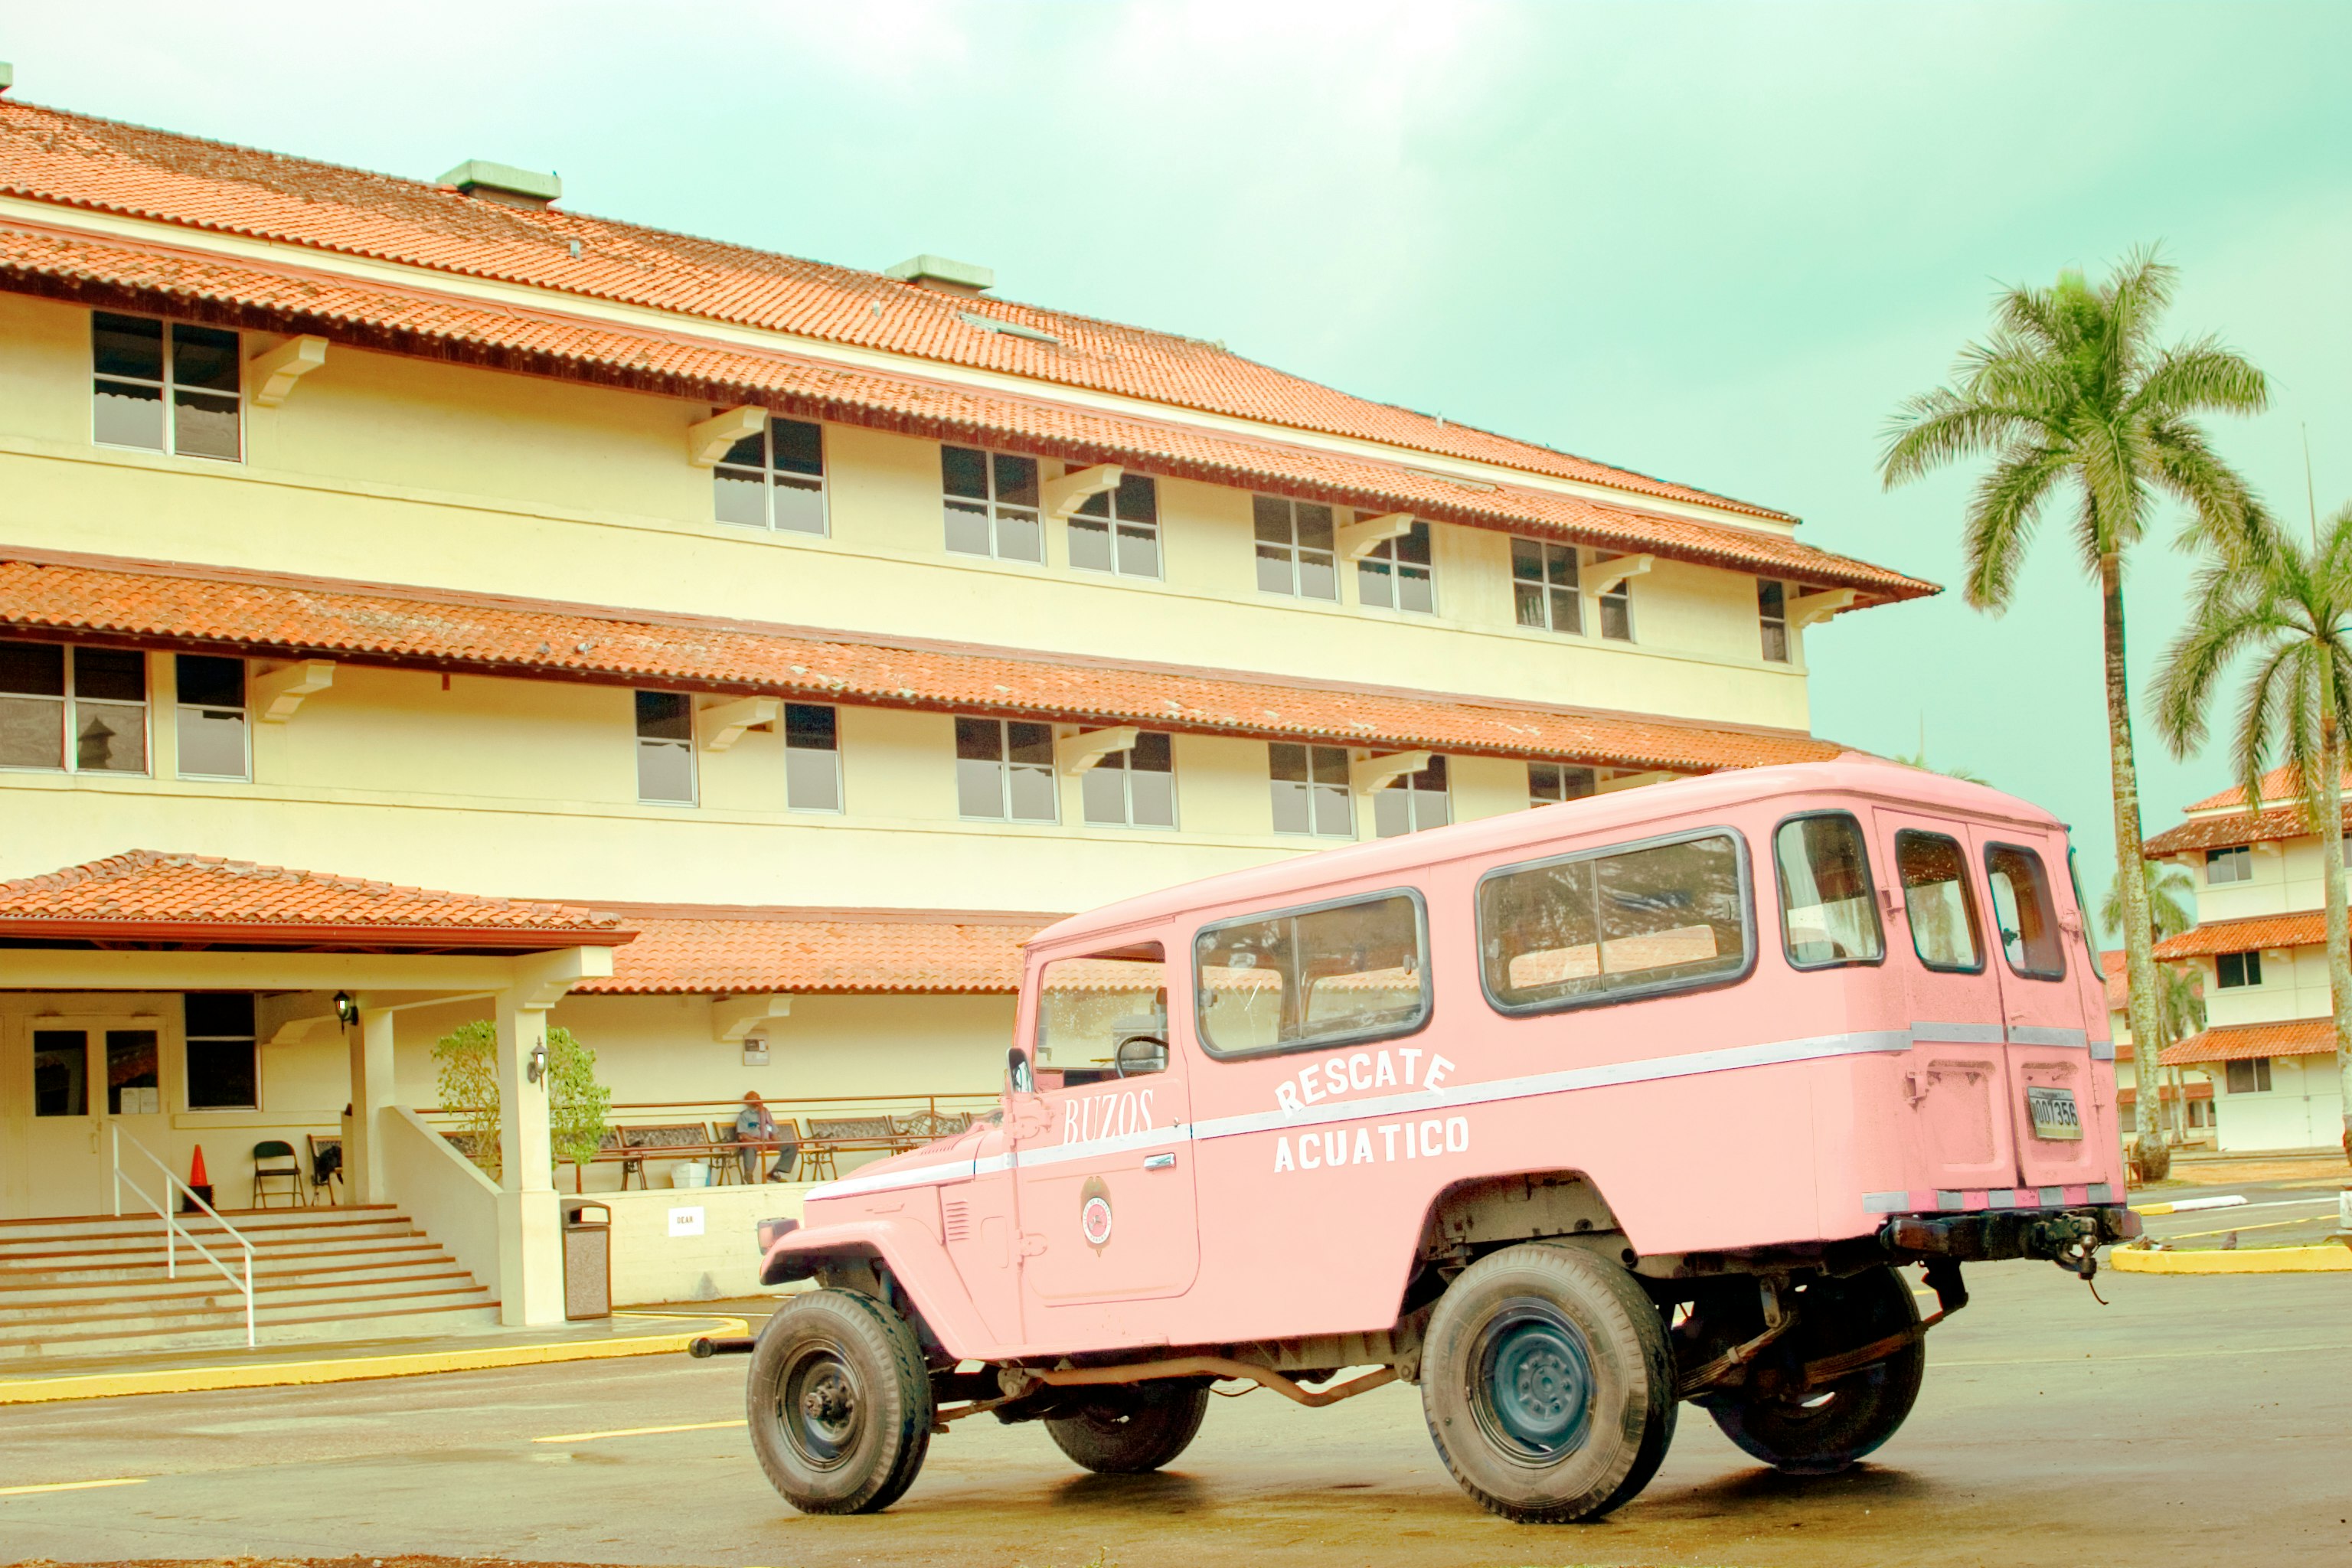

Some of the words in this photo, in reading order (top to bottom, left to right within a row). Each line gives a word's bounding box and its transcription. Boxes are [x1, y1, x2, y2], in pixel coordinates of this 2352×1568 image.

[1274, 1047, 1455, 1119] RESCATE
[1062, 1089, 1154, 1146] BUZOS
[1273, 1116, 1469, 1173] ACUATICO
